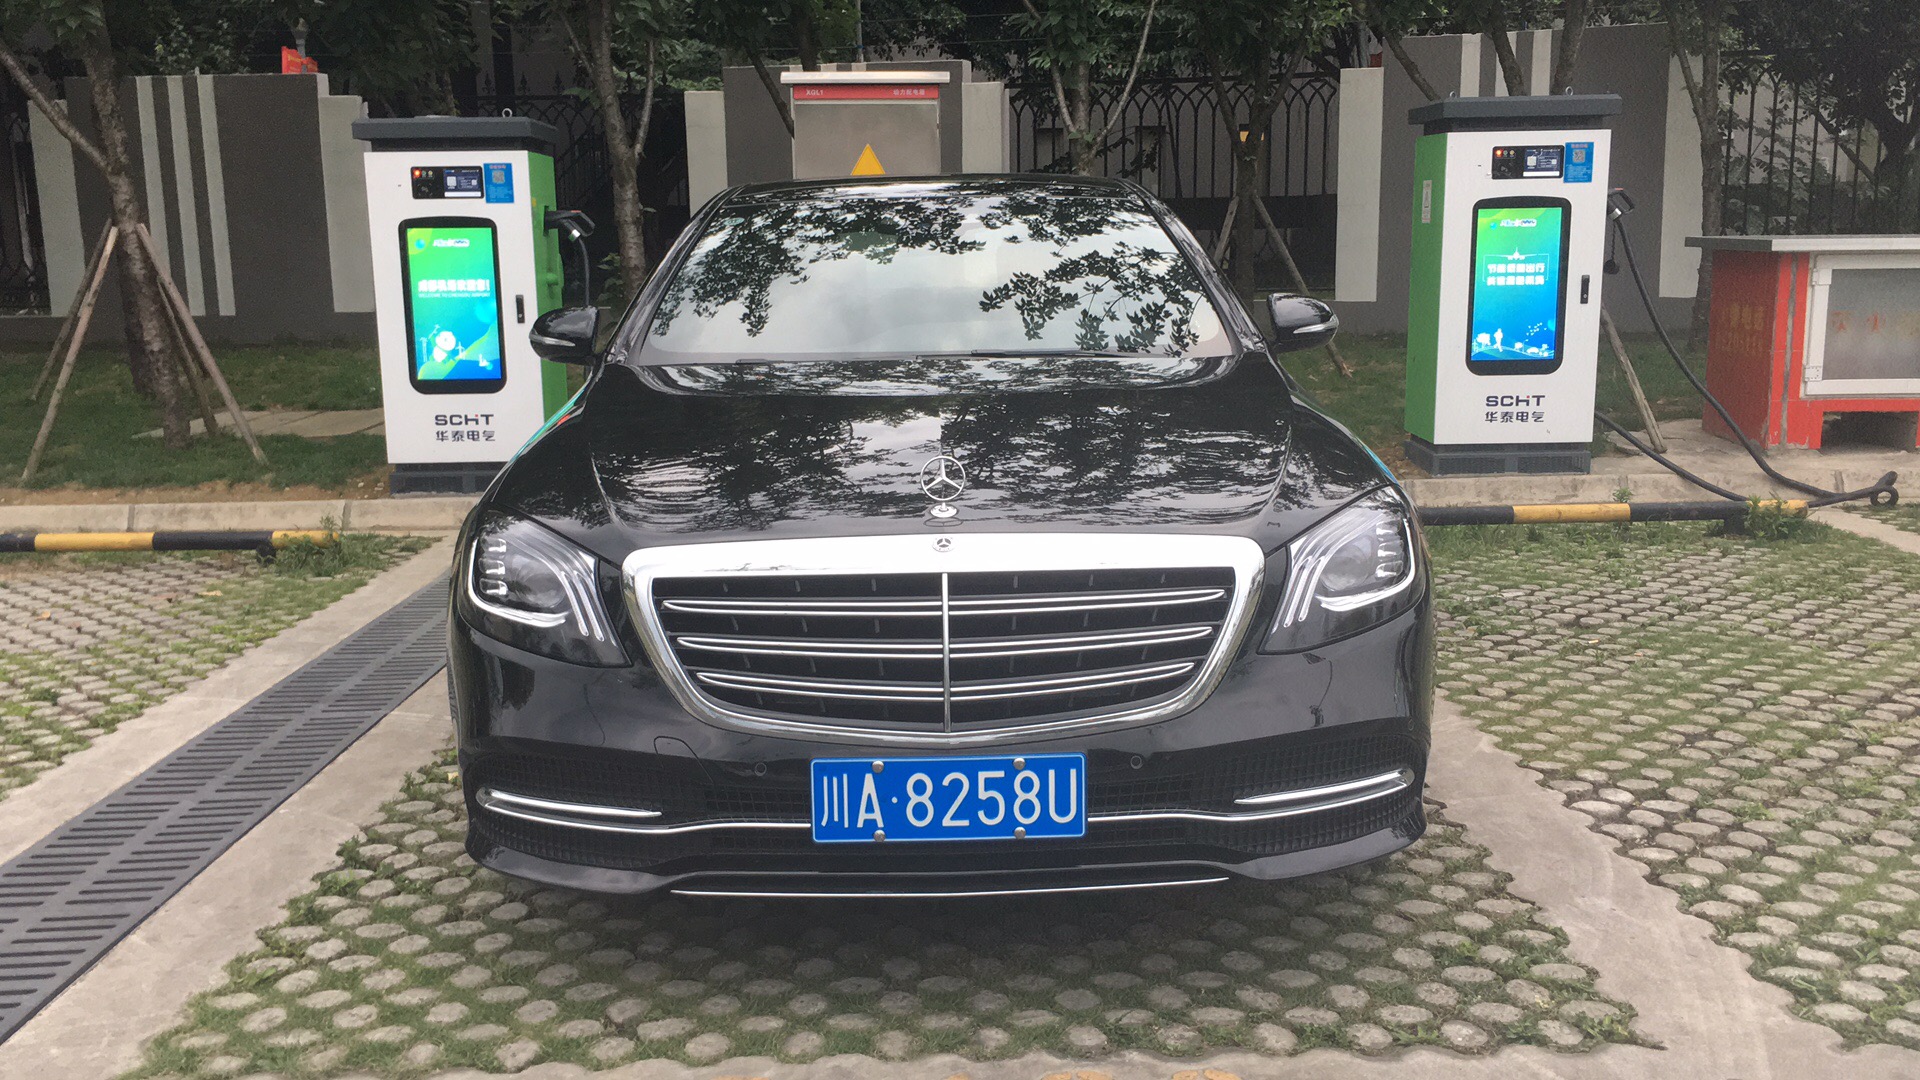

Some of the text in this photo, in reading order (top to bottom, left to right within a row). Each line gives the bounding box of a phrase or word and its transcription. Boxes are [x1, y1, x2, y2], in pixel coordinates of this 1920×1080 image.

[1485, 411, 1545, 423] 华泰电气
[436, 430, 496, 442] 华泰电气
